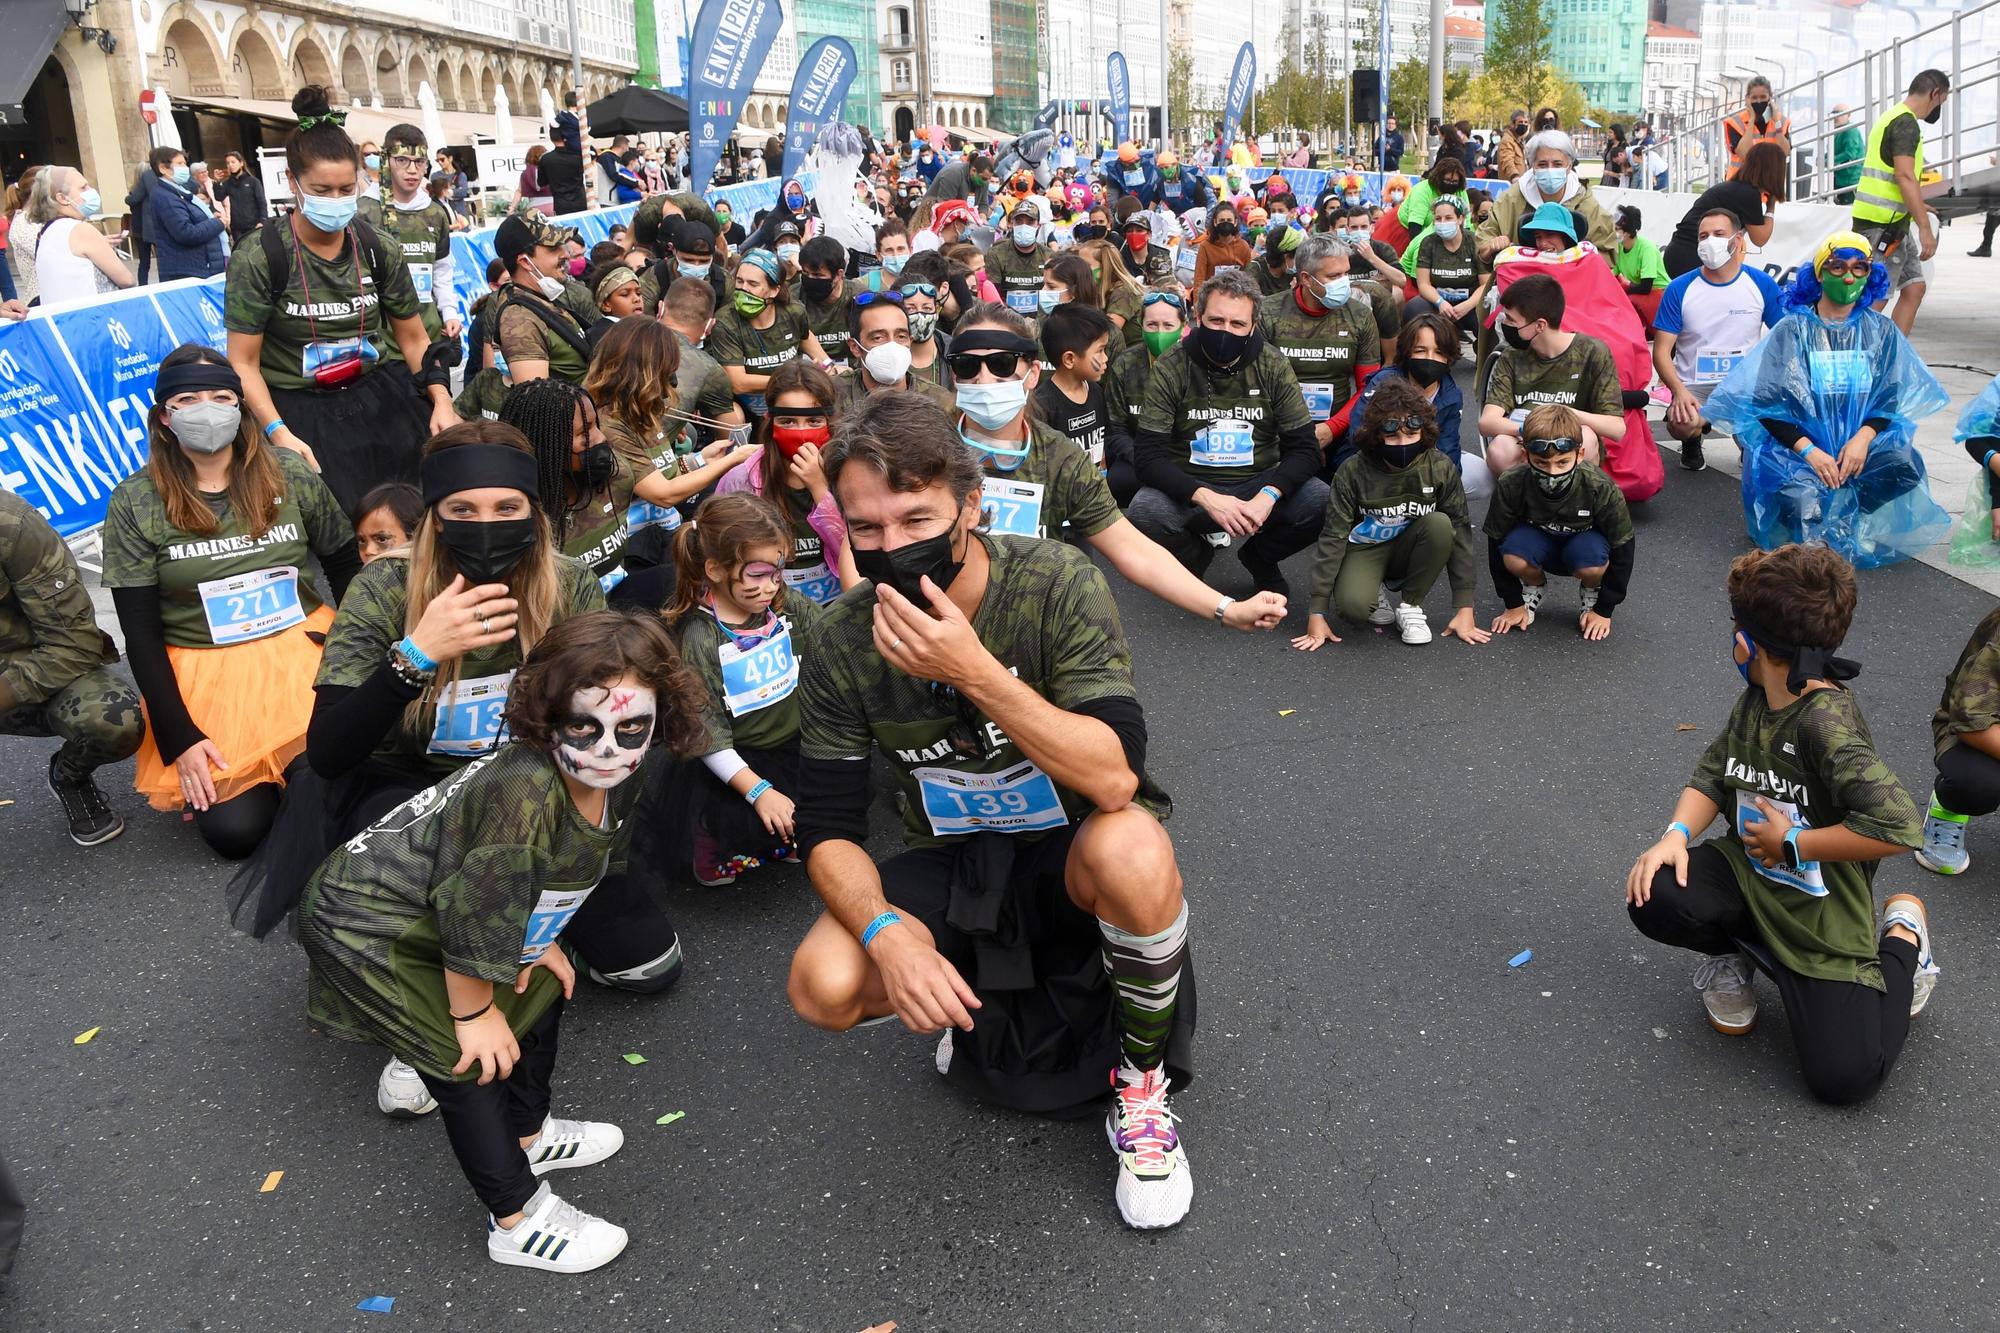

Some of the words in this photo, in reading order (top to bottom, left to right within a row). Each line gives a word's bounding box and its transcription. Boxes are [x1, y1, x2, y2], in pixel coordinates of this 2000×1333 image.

[799, 48, 839, 112] ENKIPRO
[700, 101, 731, 116] ENKI
[793, 121, 815, 133] ENKI
[286, 302, 351, 317] MARINES
[1325, 347, 1349, 359] ENKI
[1713, 360, 1731, 372] 19
[0, 383, 41, 402] undación
[1187, 407, 1233, 420] MARINES
[1234, 406, 1263, 420] ENKI
[1210, 434, 1235, 451] 98
[168, 535, 254, 560] MARINES
[257, 523, 298, 546] ENKI
[227, 586, 281, 621] 271
[406, 648, 424, 664] ENKI
[745, 644, 787, 684] 426
[967, 779, 988, 787] ENKI
[947, 791, 1028, 815] 139
[989, 818, 1027, 829] REPSOL
